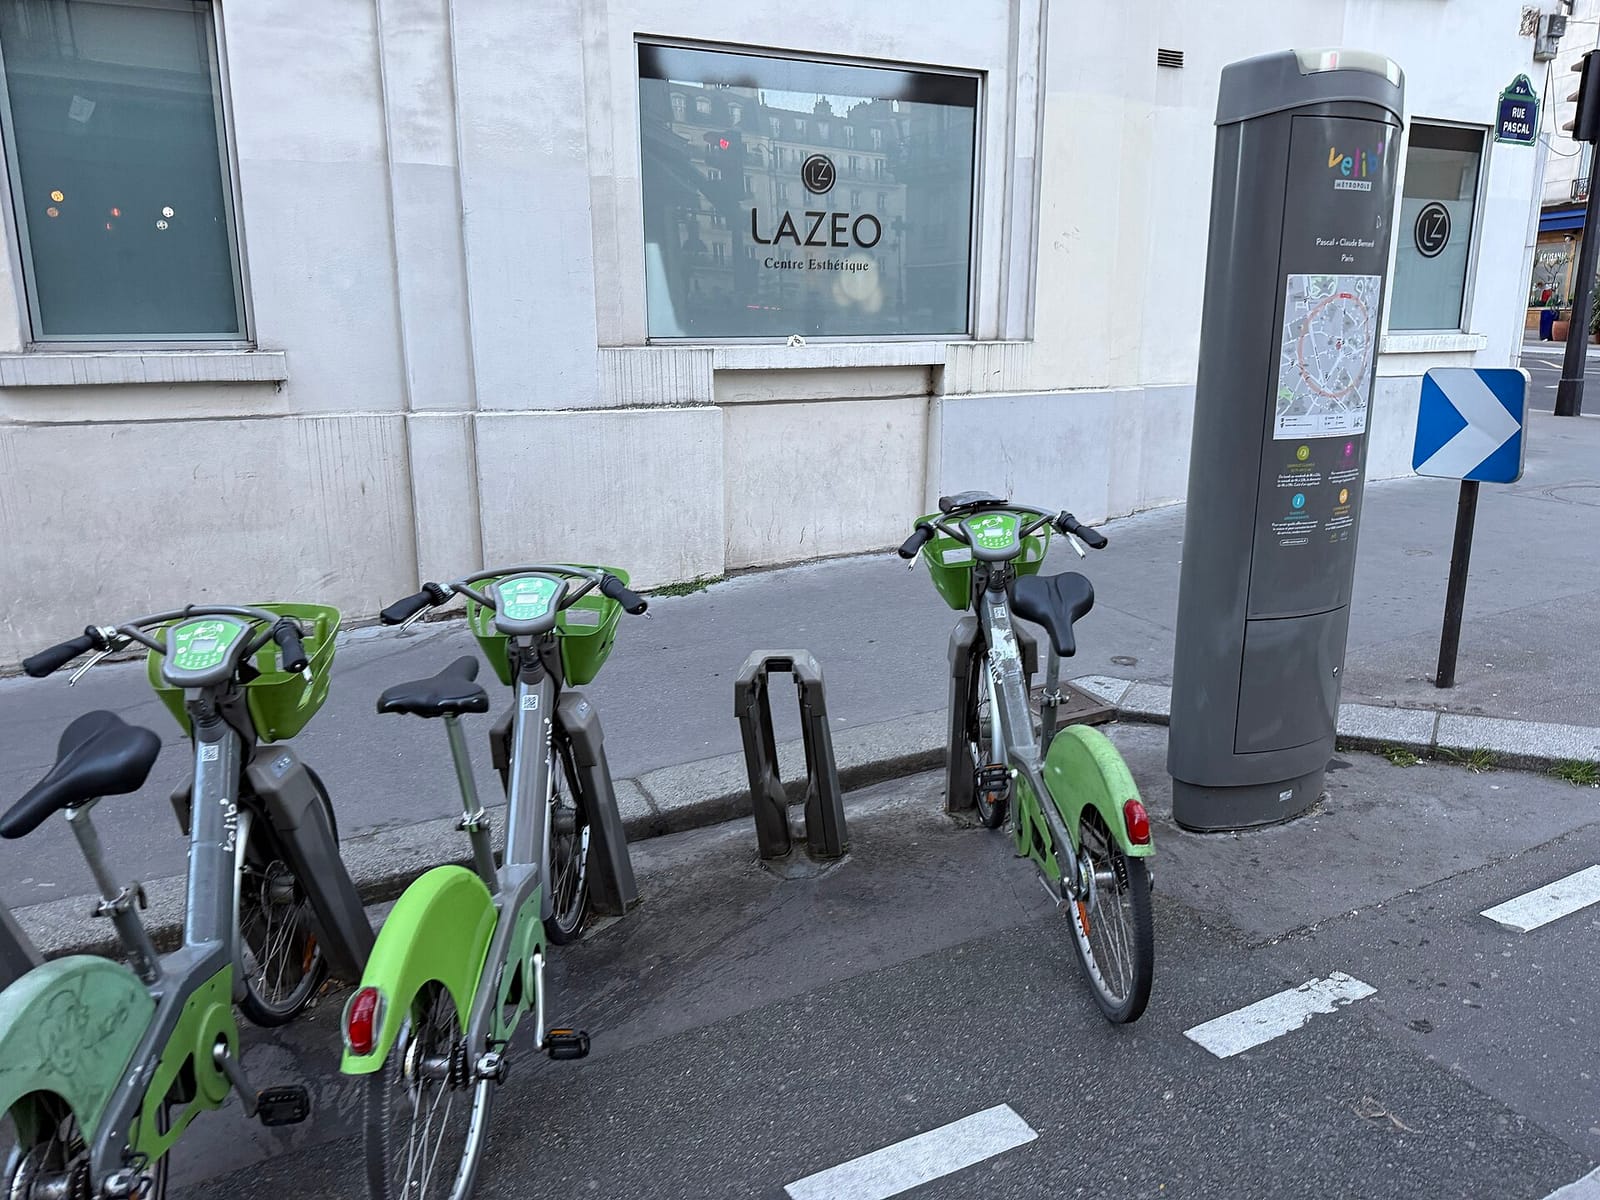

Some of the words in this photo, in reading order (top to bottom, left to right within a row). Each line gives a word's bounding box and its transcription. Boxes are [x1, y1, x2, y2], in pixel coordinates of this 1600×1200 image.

[1512, 107, 1526, 119] RUE
[1503, 121, 1530, 135] PASCAL
[751, 207, 882, 249] LAZEO
[1315, 237, 1335, 246] Pascal
[764, 257, 804, 270] Centre
[807, 258, 870, 273] Esthétique
